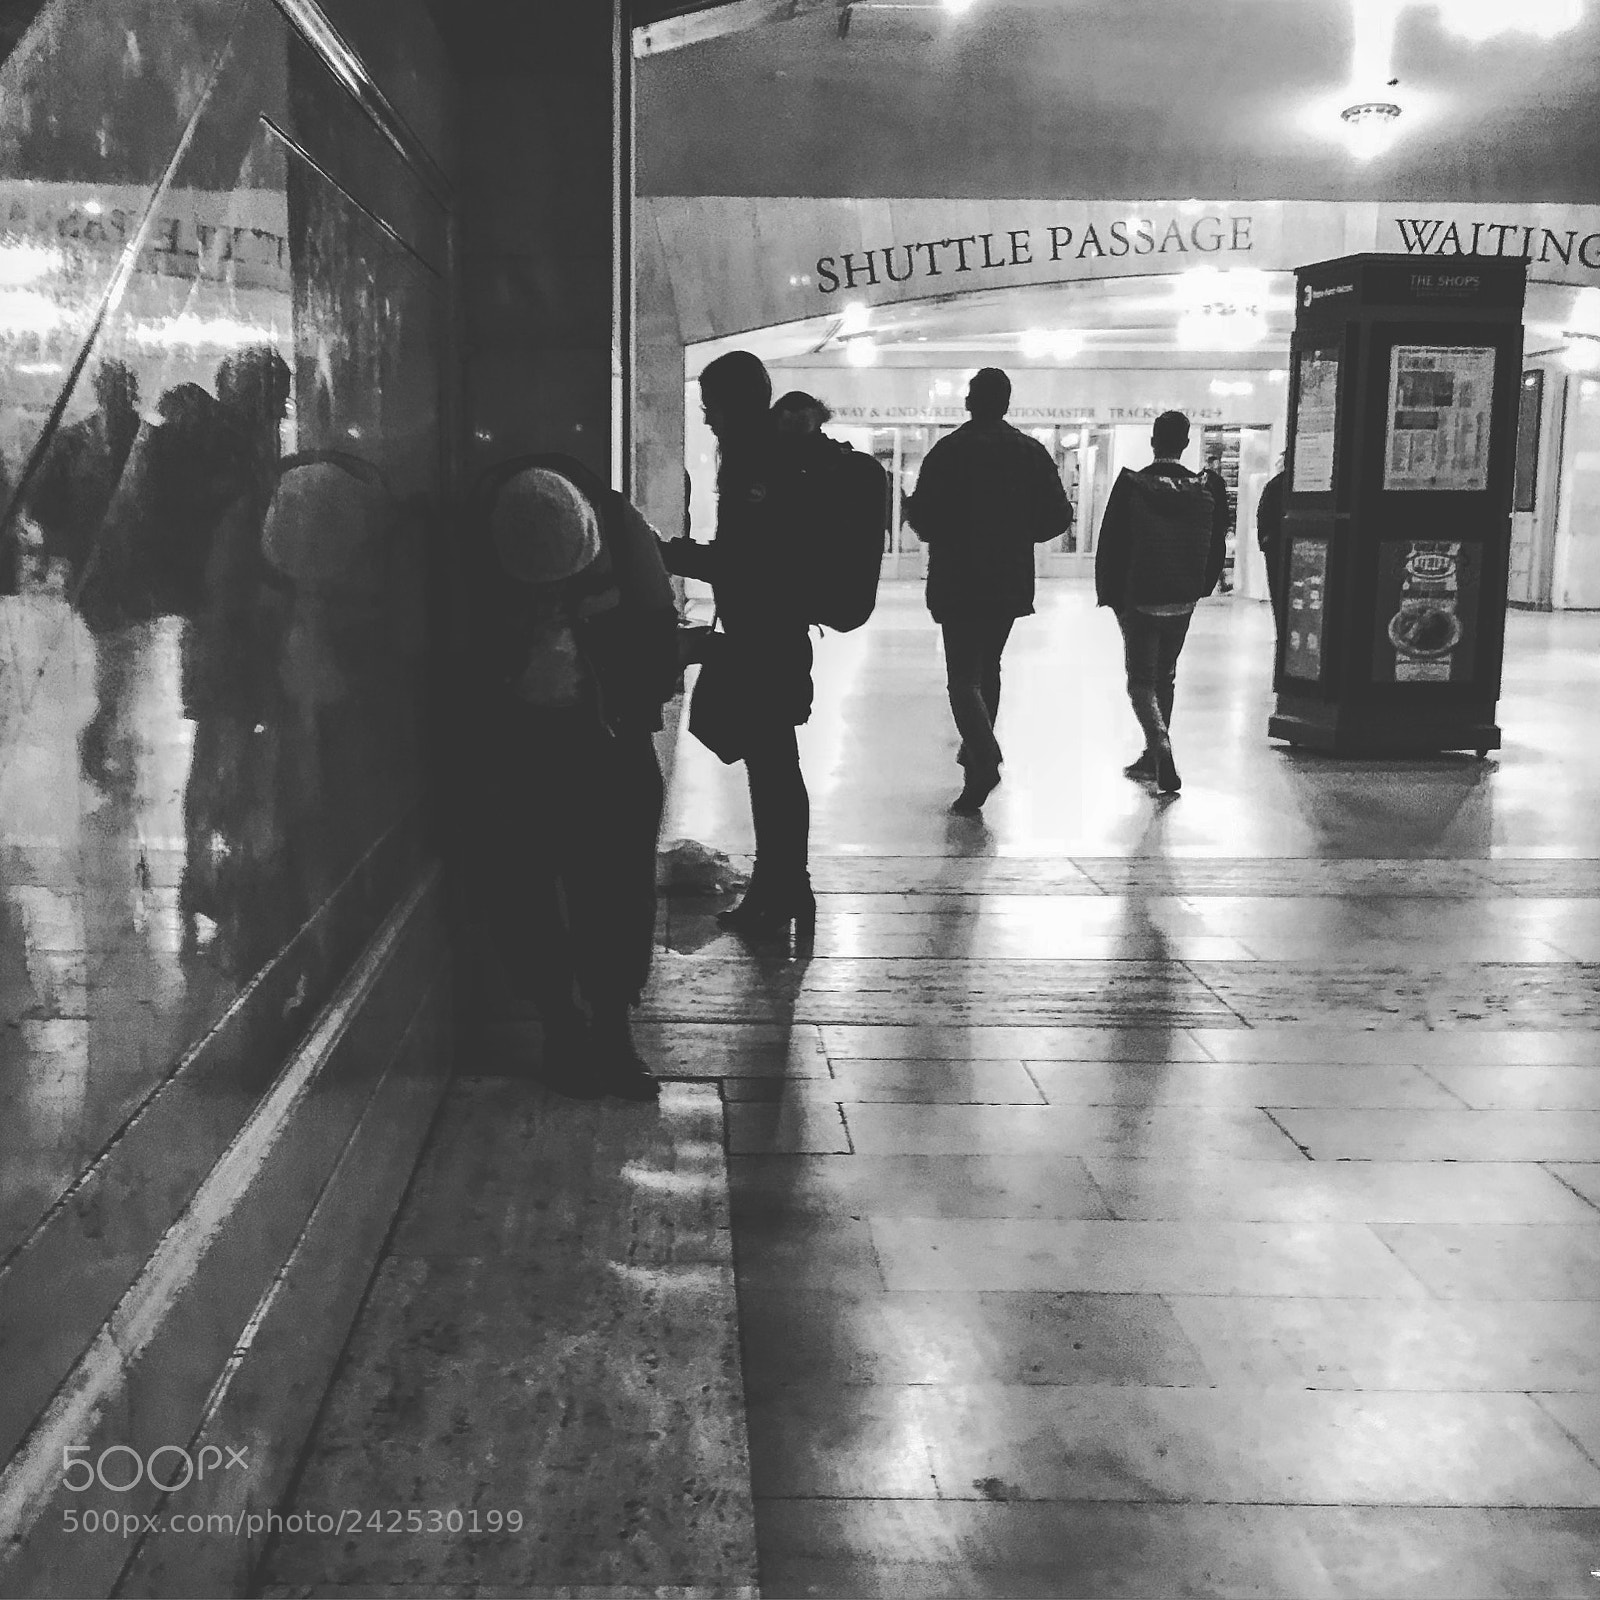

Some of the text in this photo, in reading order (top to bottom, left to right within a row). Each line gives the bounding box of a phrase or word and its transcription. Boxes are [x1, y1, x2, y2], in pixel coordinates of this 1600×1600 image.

[816, 216, 1254, 293] SHUTTLE PASSAGE
[1410, 275, 1480, 287] THE SHOPS
[830, 406, 867, 418] WAY
